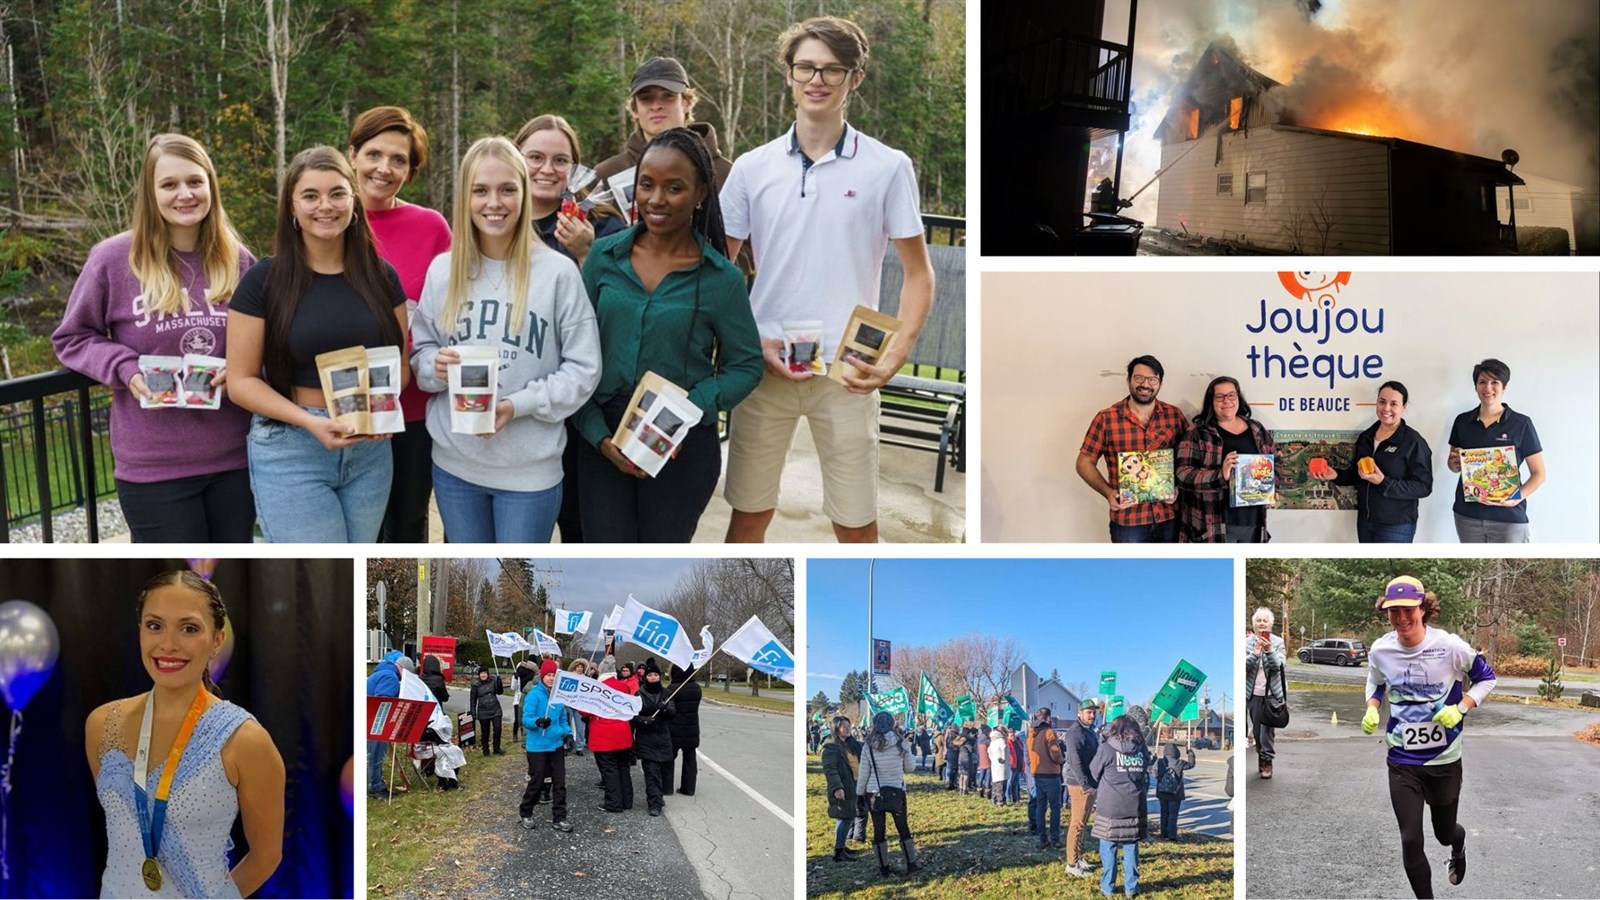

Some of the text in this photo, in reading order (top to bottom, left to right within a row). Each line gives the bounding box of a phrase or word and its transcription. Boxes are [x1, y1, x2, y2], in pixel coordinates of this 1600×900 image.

[1246, 299, 1384, 344] Joujou
[1246, 342, 1384, 389] thèque
[1279, 398, 1350, 411] DE BEAUCE
[580, 681, 636, 713] SPSCA
[1405, 724, 1442, 745] 256
